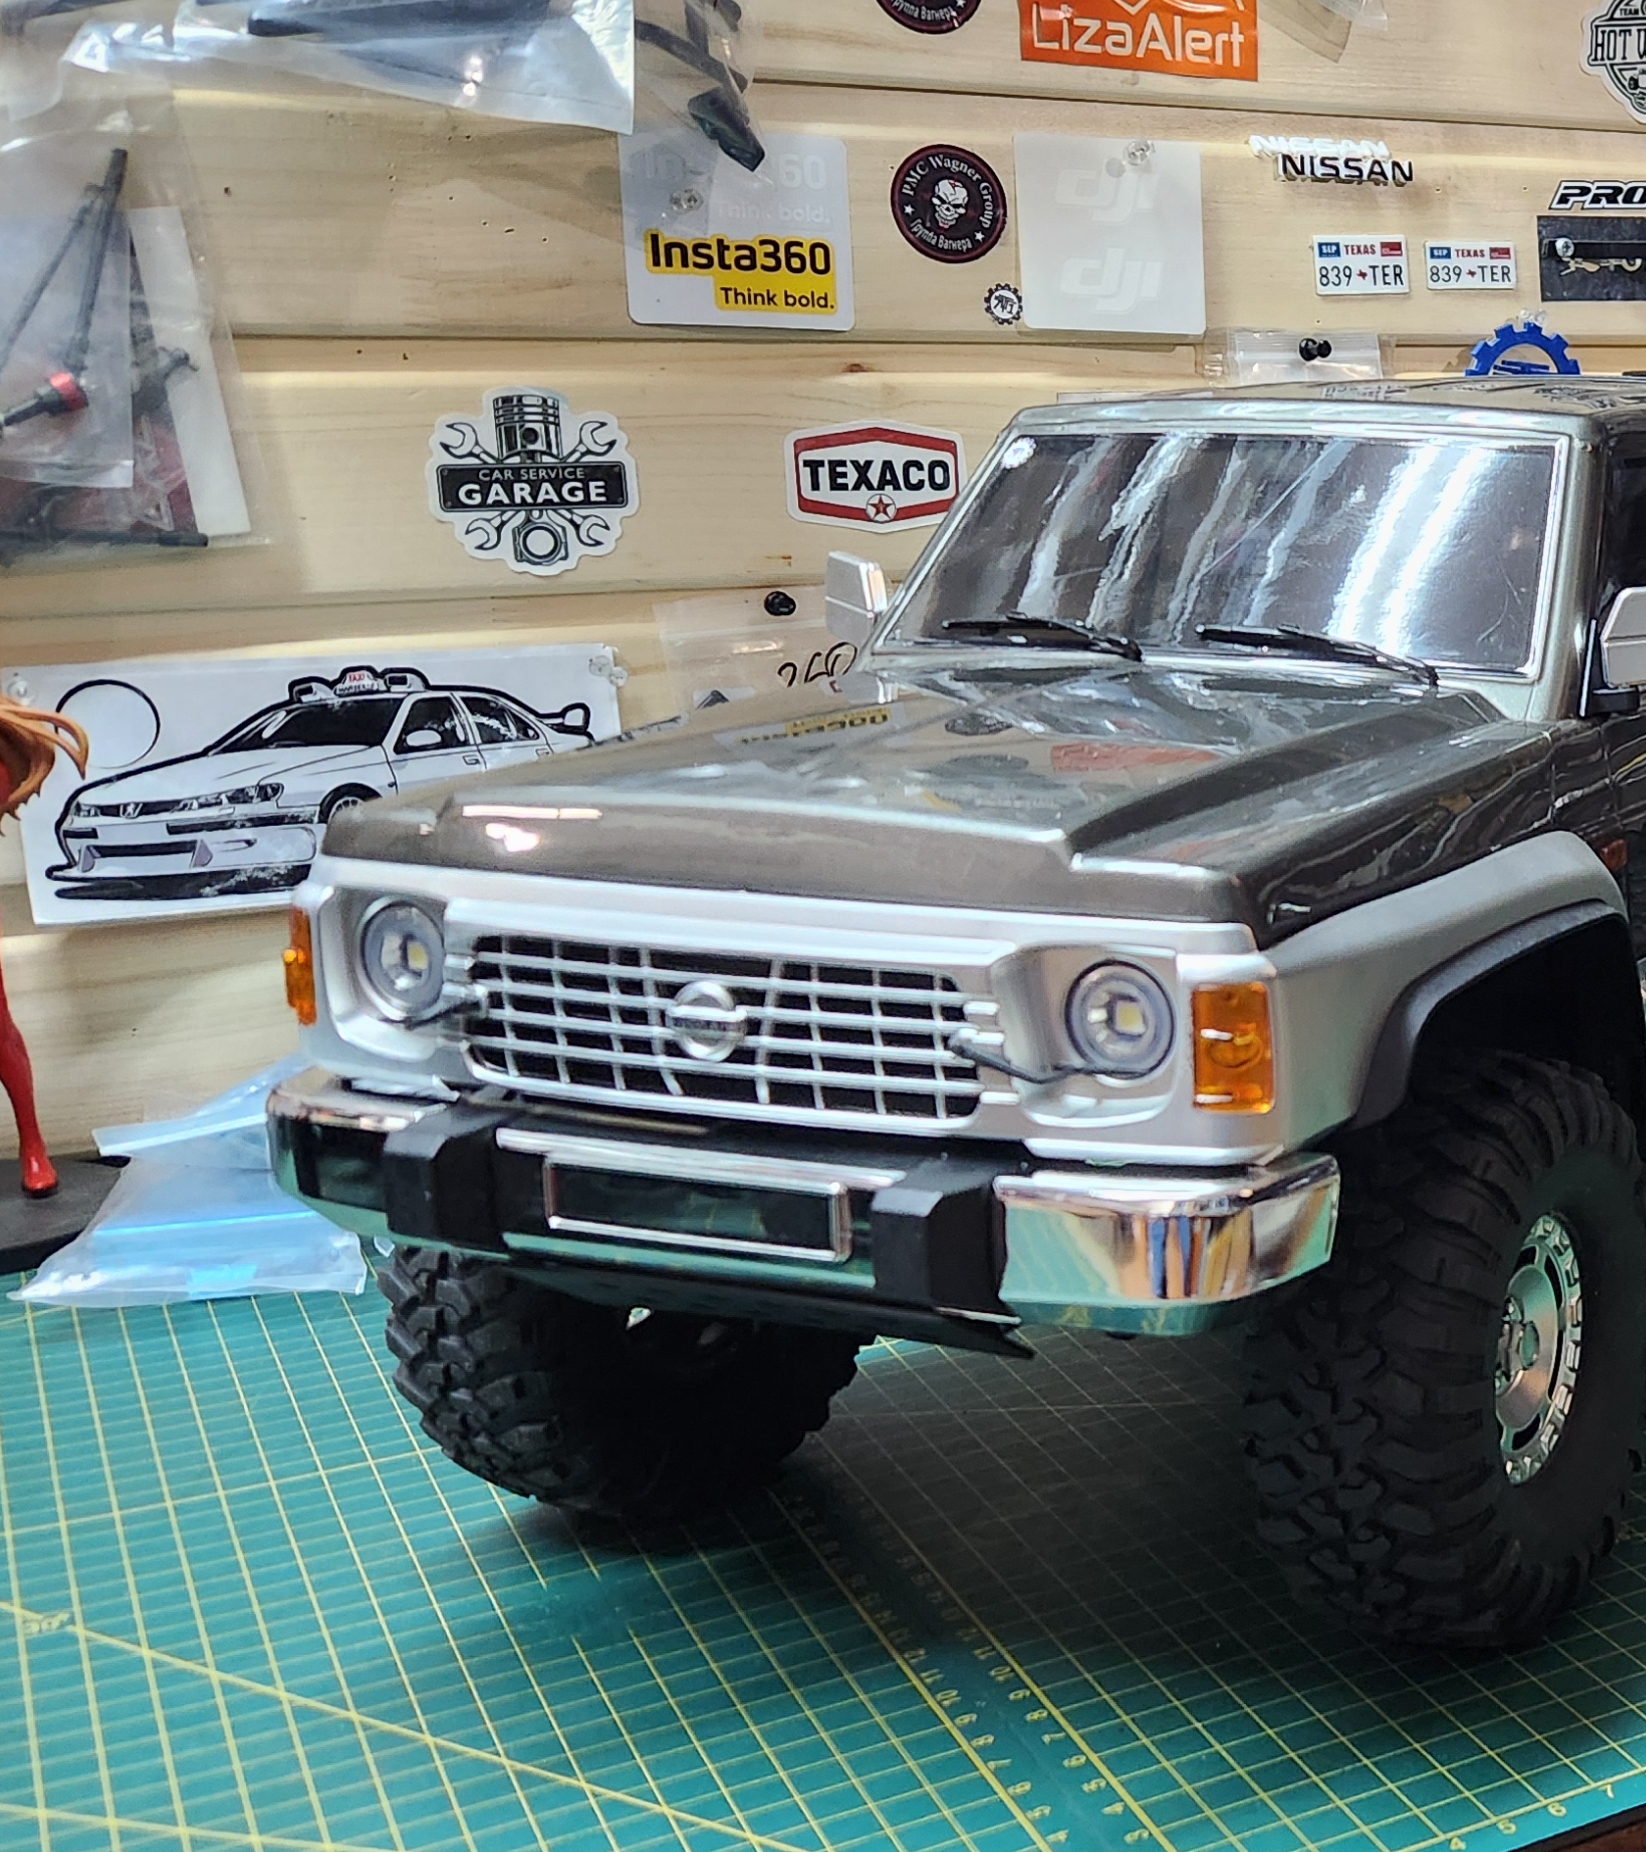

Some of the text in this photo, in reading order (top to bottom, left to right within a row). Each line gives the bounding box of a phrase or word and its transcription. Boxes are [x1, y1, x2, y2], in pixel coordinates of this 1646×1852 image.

[892, 0, 919, 18] руппа
[1619, 7, 1640, 17] TEAM
[1031, 3, 1245, 68] LizaAlert
[1591, 25, 1632, 62] HOT
[1279, 153, 1414, 187] NISSAN
[901, 154, 994, 229] PMC Wagner Group
[649, 233, 831, 275] Insta360
[1343, 244, 1376, 256] TEXAS
[1454, 248, 1486, 258] TEXAS
[1319, 264, 1405, 287] 839 TER
[1429, 265, 1511, 283] 839 TER
[719, 286, 835, 310] Think bold.
[478, 467, 585, 481] CAR SERVICE
[802, 458, 951, 493] TEXACO
[457, 481, 608, 505] GARAGE
